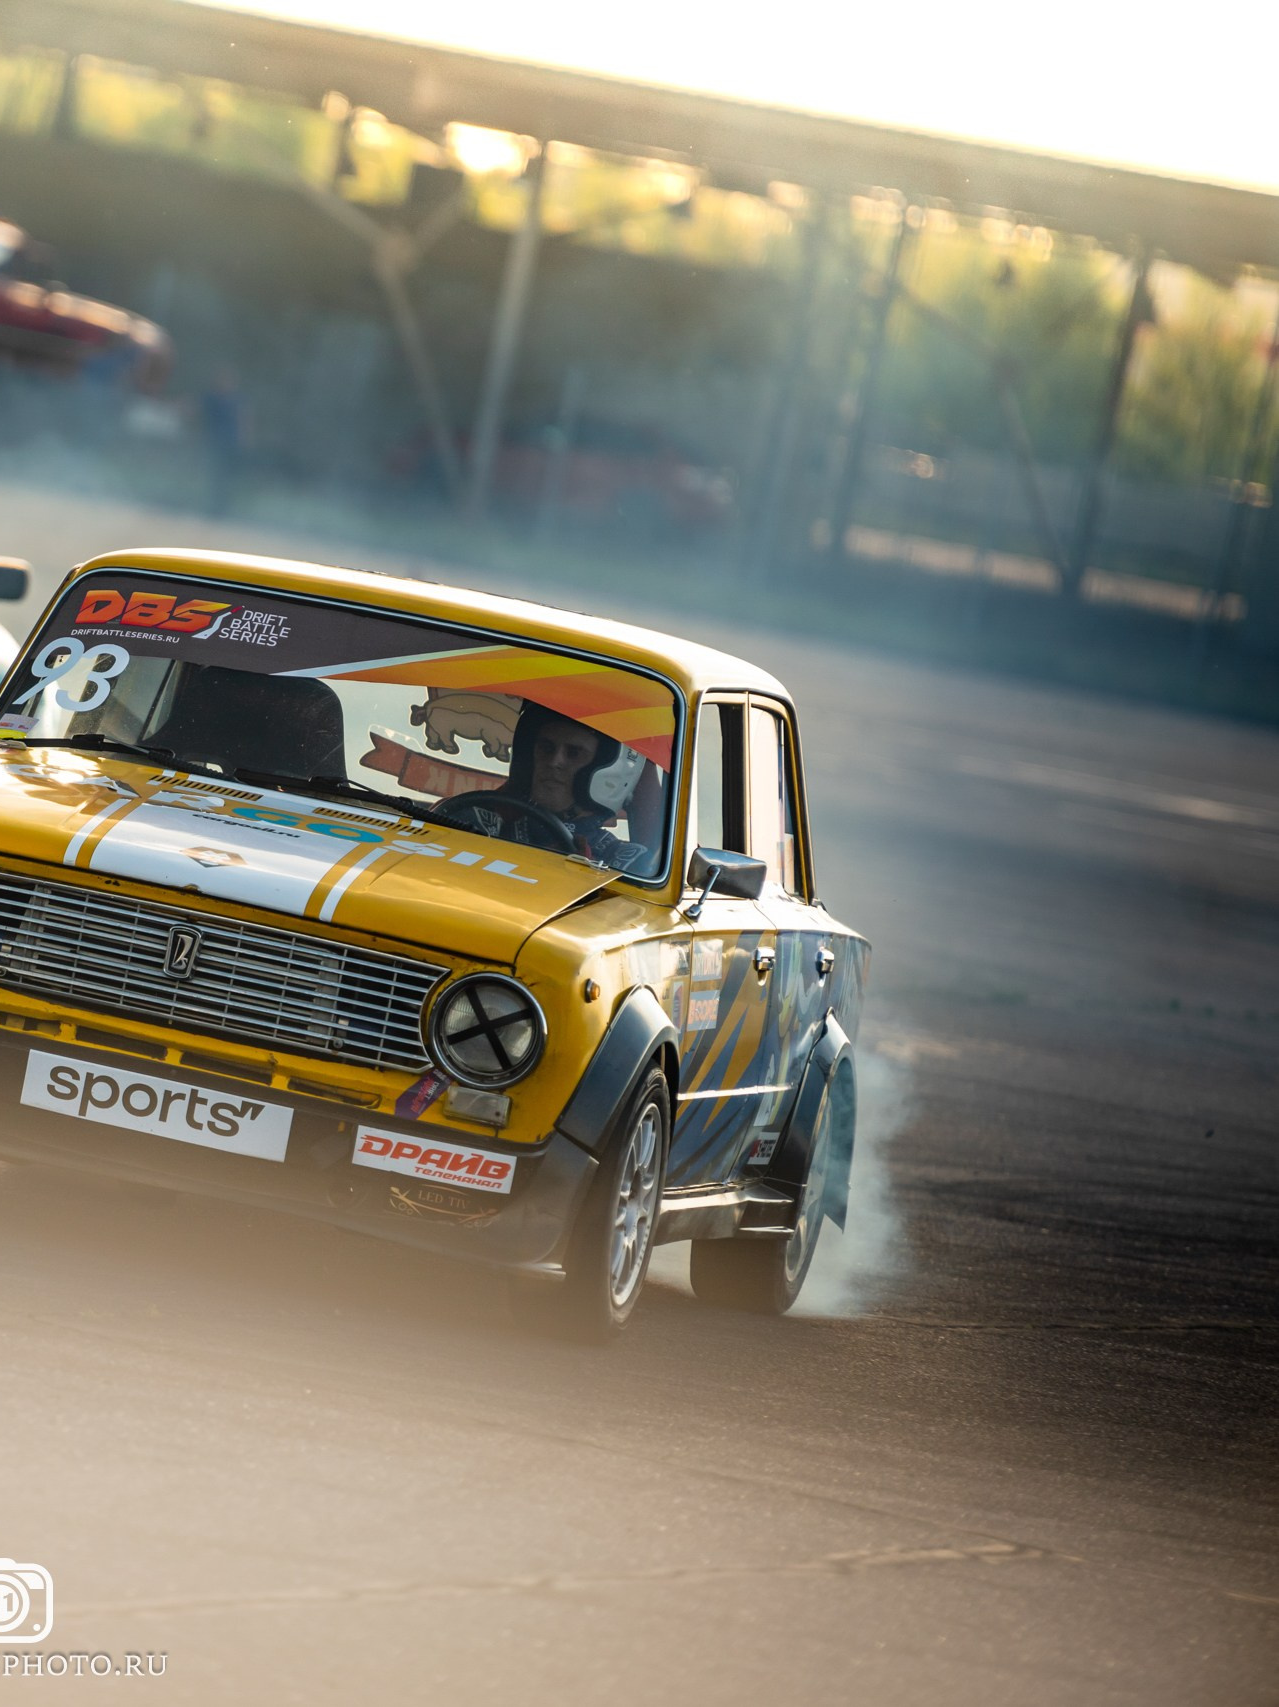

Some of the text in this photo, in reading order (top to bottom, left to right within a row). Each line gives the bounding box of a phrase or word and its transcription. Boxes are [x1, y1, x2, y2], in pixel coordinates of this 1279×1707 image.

[75, 589, 231, 633] DBS
[241, 609, 288, 627] DRIFT
[70, 628, 181, 644] DRIFTBATTLESERIES.RU
[218, 627, 279, 647] SERIES
[230, 618, 292, 639] BATTLE
[12, 636, 131, 712] 93
[358, 1134, 512, 1180] ДРАЙВ
